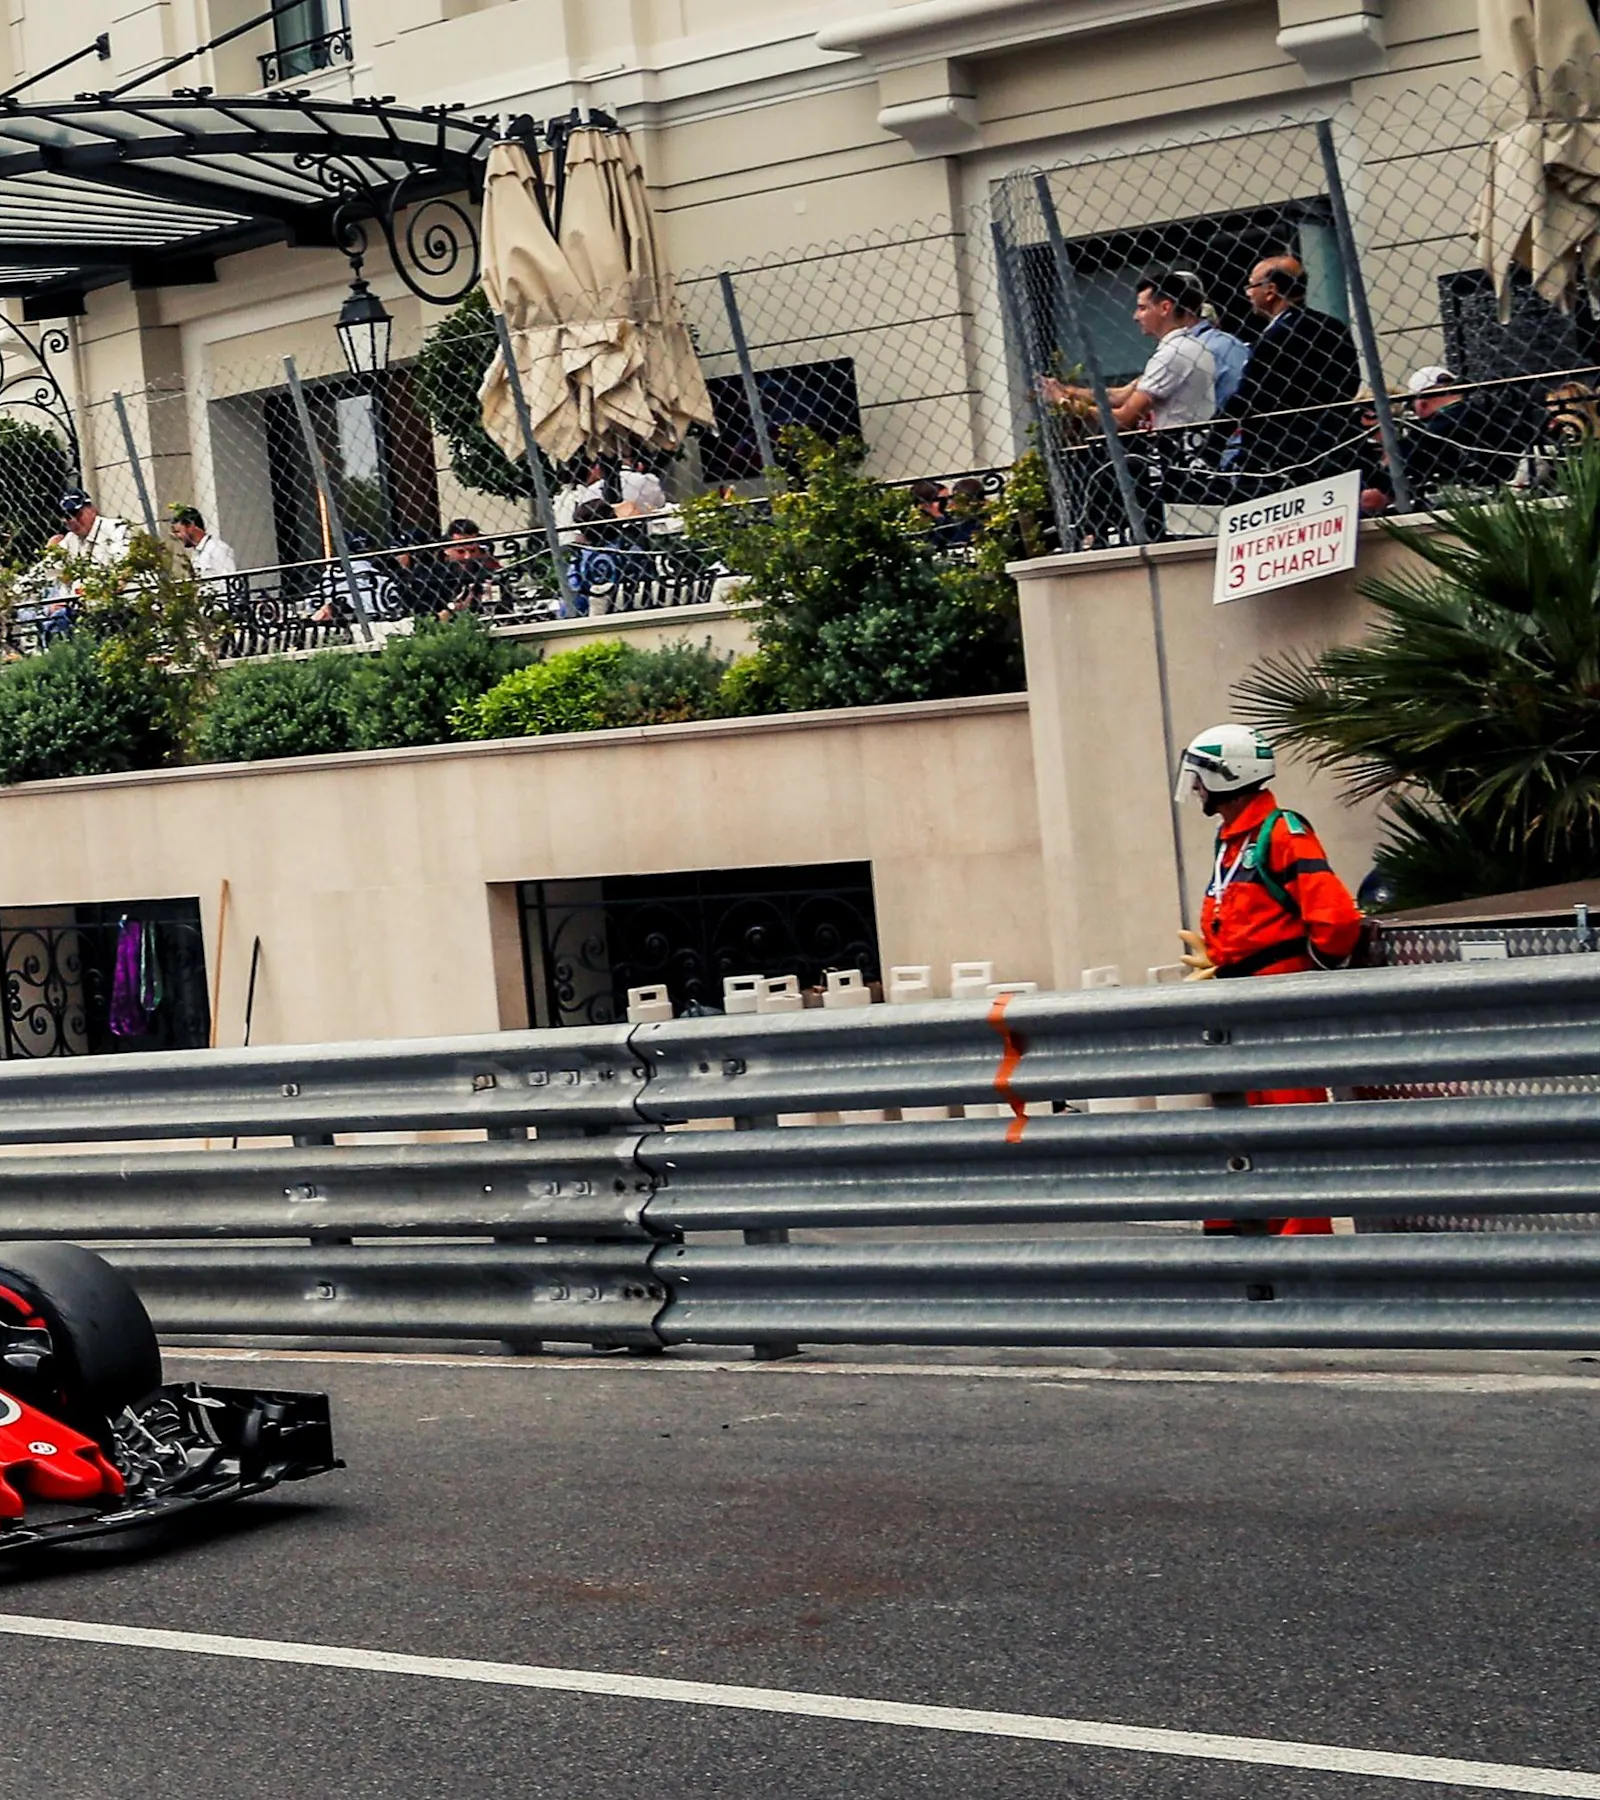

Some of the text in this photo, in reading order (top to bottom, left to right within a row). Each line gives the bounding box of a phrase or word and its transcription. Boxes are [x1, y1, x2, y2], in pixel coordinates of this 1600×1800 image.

[1228, 498, 1306, 533] SECTEUR
[1322, 491, 1335, 506] 3
[1230, 516, 1344, 562] INTERVENTION
[1229, 542, 1340, 588] 3 CHARLY
